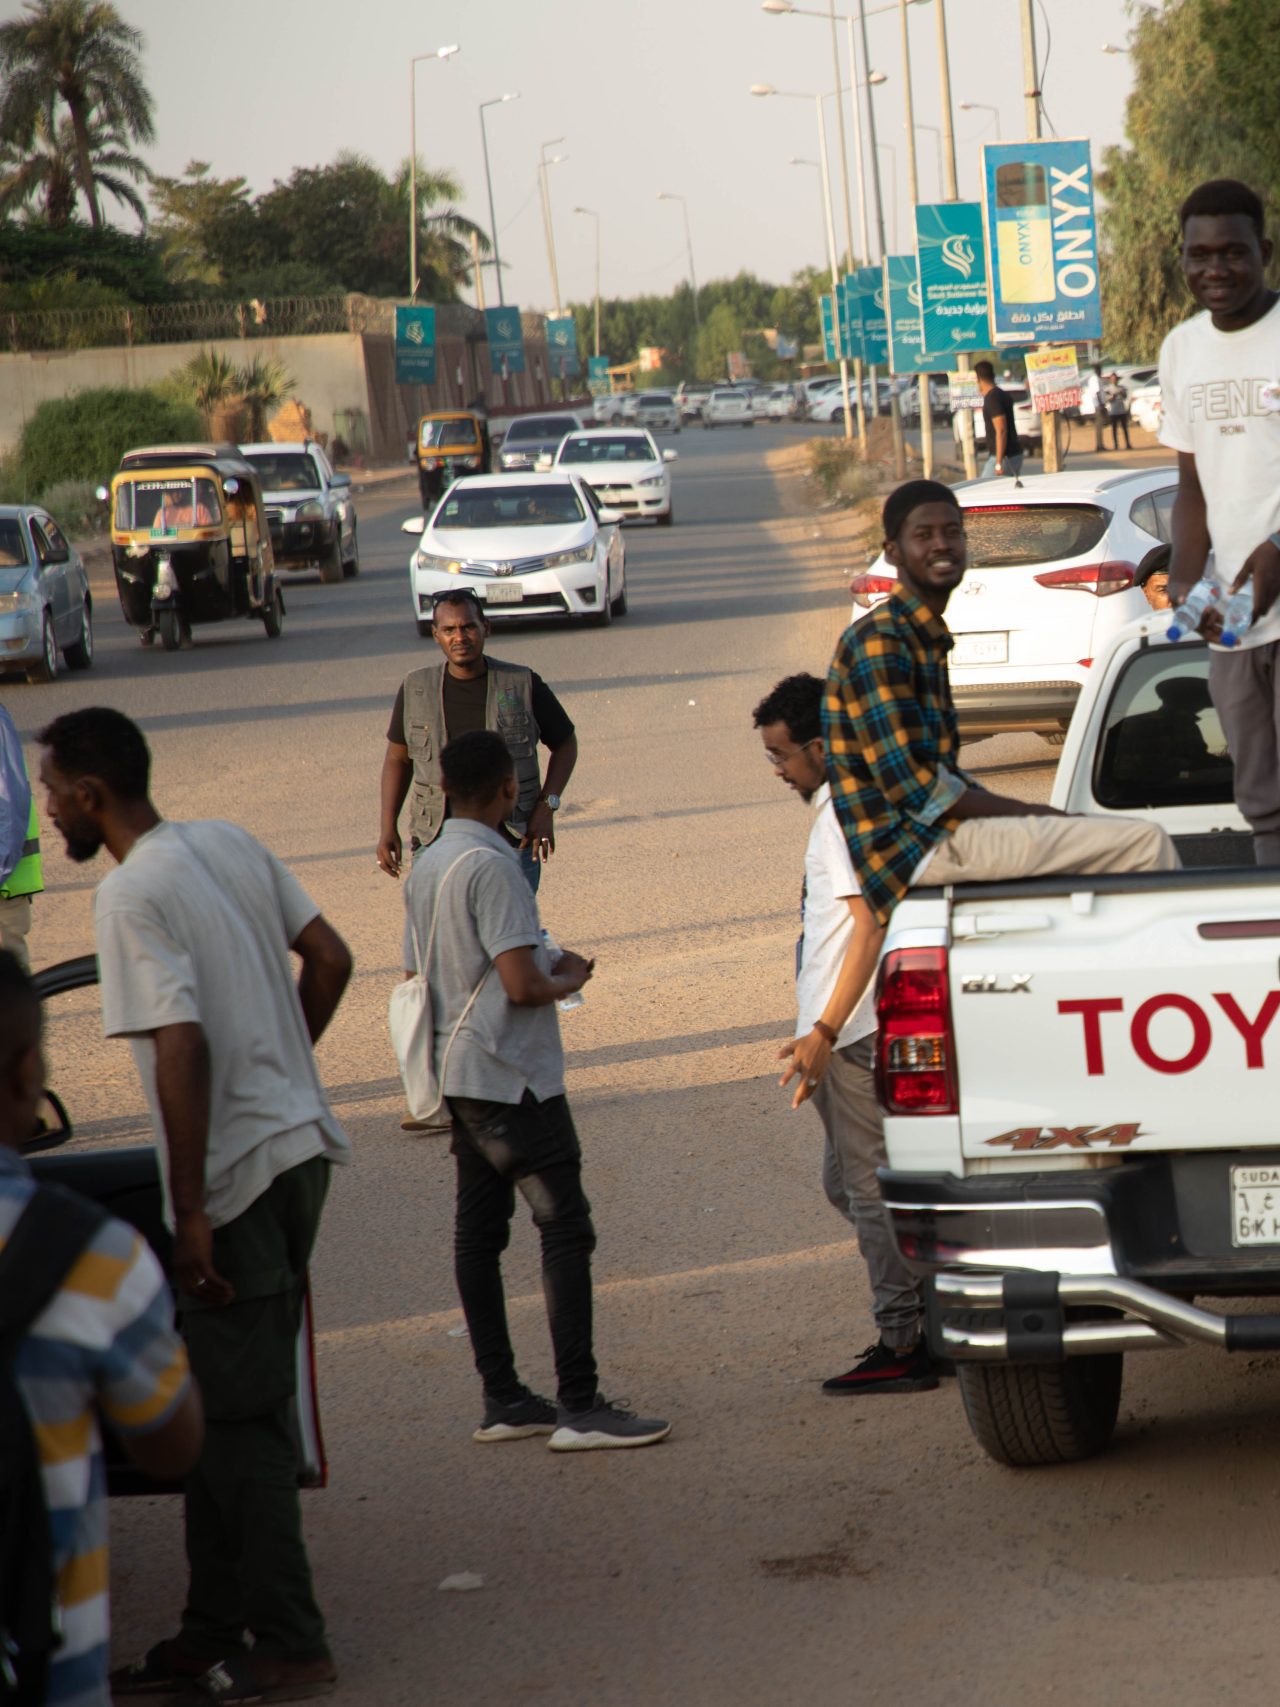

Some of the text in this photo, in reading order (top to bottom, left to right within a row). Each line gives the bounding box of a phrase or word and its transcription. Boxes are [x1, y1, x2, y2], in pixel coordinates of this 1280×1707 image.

[1017, 222, 1032, 265] ONYX
[1050, 164, 1096, 298] ONYX
[961, 974, 1032, 994] GLX
